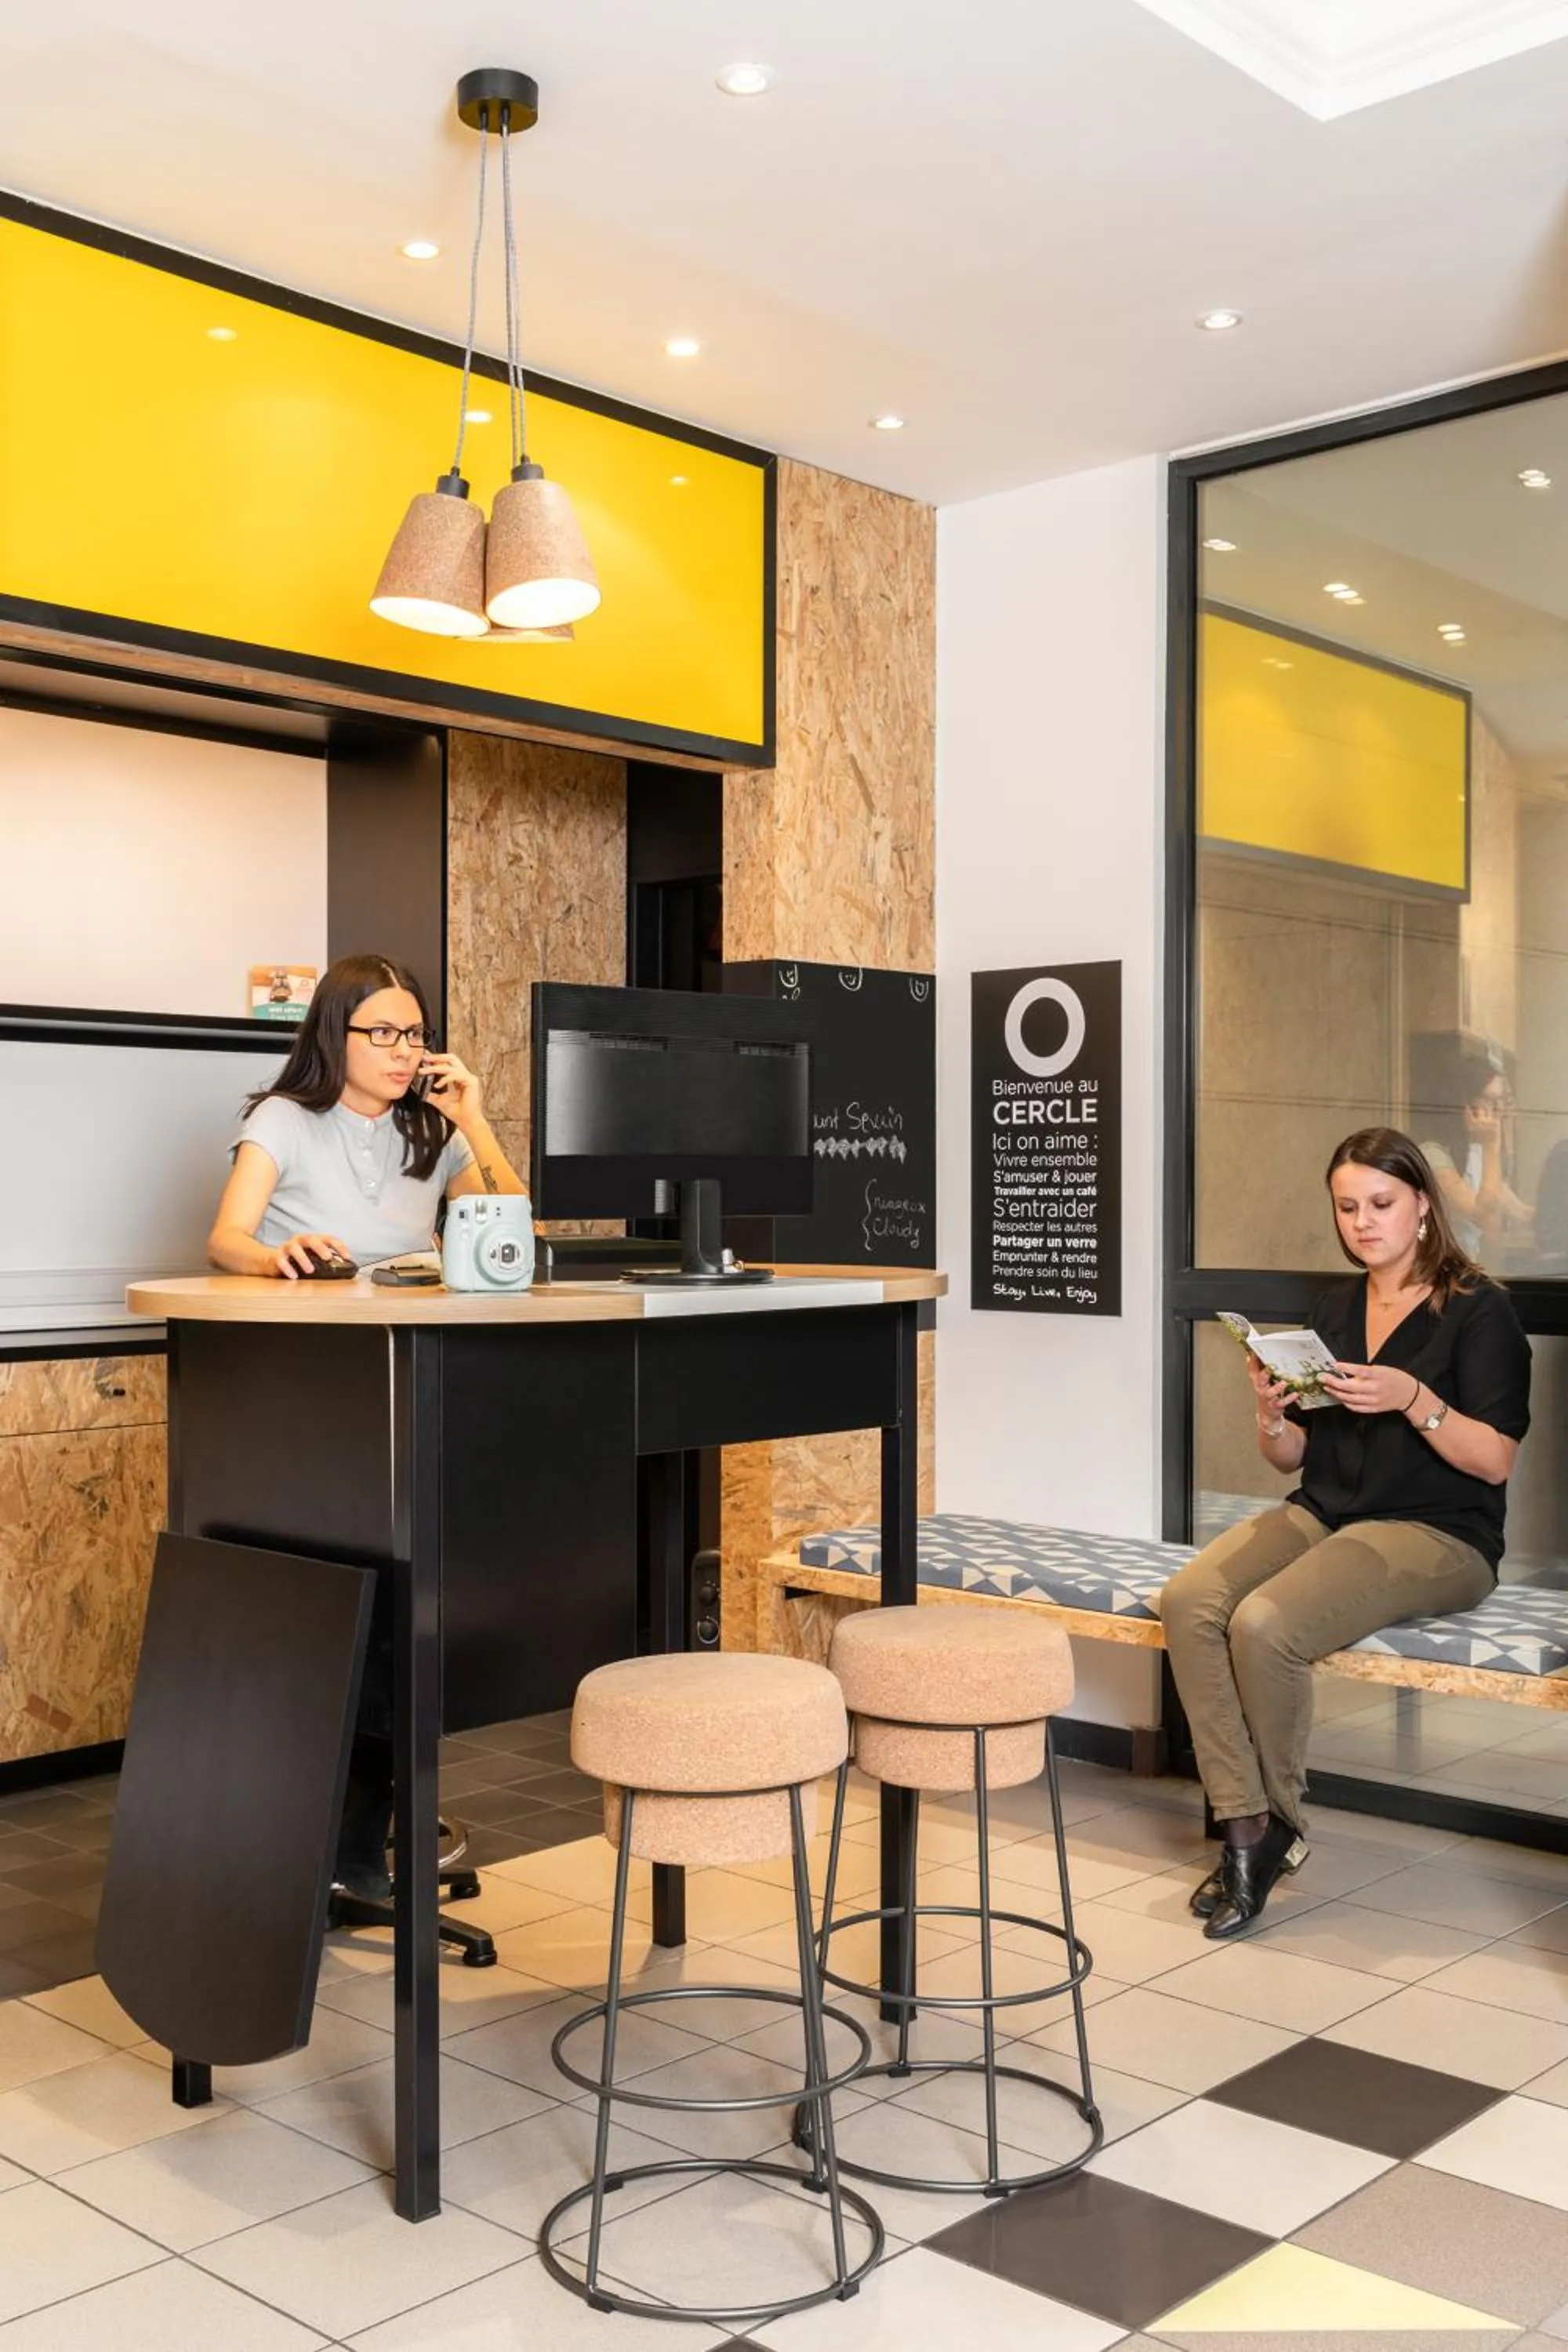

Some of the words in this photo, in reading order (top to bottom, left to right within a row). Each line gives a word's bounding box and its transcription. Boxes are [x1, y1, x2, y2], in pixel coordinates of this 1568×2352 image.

[993, 1080, 1073, 1096] Bienvenue
[1078, 1080, 1098, 1093] au
[993, 1098, 1098, 1125] CERCLE
[993, 1133, 1011, 1150] Ici
[1017, 1136, 1039, 1150] on
[1045, 1132, 1087, 1149] aime
[994, 1153, 1027, 1167] Vivre
[1032, 1152, 1097, 1167] ensemble
[993, 1171, 1049, 1183] S'amuser
[1052, 1170, 1061, 1182] &
[1064, 1171, 1097, 1185] jouer
[994, 1186, 1036, 1196] Travailler
[1076, 1186, 1097, 1196] café
[993, 1198, 1097, 1218] S'entraider
[993, 1220, 1044, 1232] Respecter
[1047, 1221, 1062, 1232] les
[1064, 1223, 1098, 1232] autres
[993, 1236, 1044, 1249] Partager
[1047, 1238, 1062, 1247] un
[1065, 1238, 1097, 1248] verre
[993, 1250, 1048, 1263] Emprunter
[1051, 1251, 1058, 1263] &
[1062, 1252, 1097, 1263] rendre
[993, 1265, 1033, 1277] Prendre
[1036, 1266, 1058, 1277] soin
[1062, 1267, 1075, 1278] du
[1079, 1267, 1098, 1279] lieu
[1066, 1287, 1097, 1304] Enjoy
